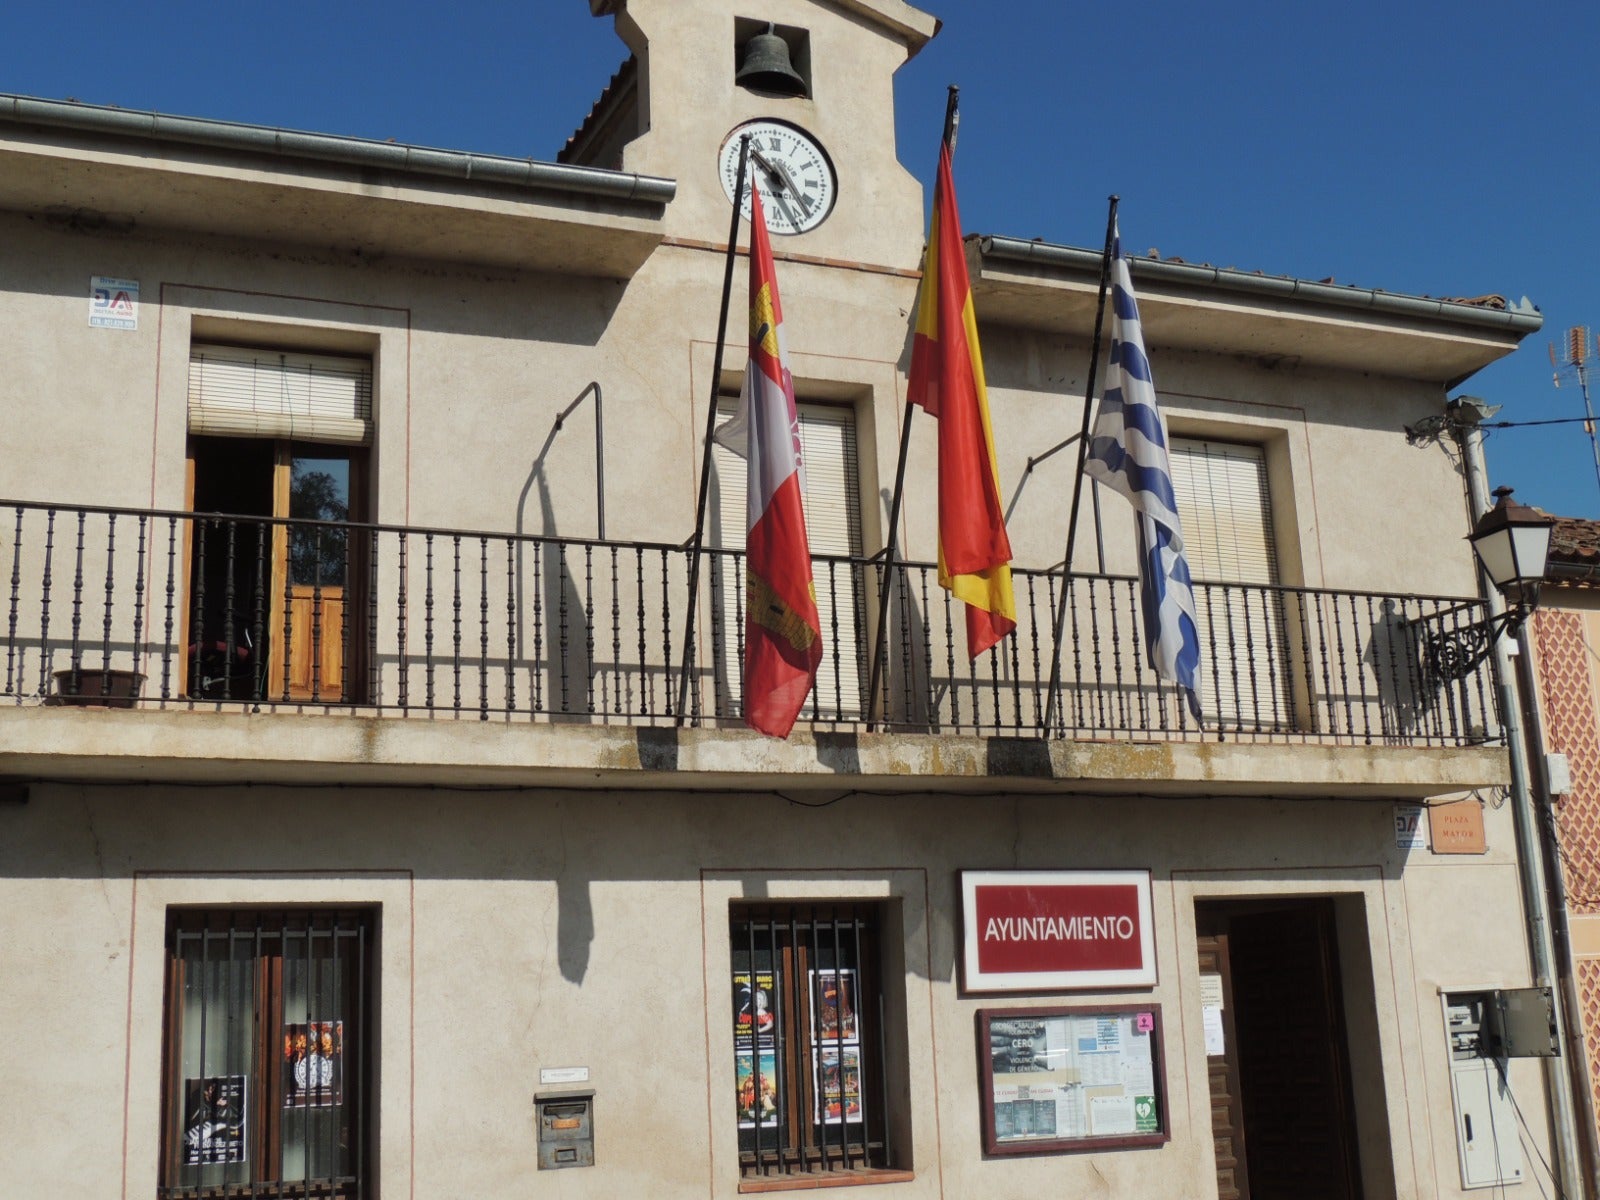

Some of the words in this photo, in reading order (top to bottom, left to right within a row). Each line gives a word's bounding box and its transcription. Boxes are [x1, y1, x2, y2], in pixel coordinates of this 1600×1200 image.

[1442, 830, 1474, 839] MAYOR
[984, 915, 1135, 942] AYUNTAMIENTO
[1012, 1039, 1033, 1048] CERO
